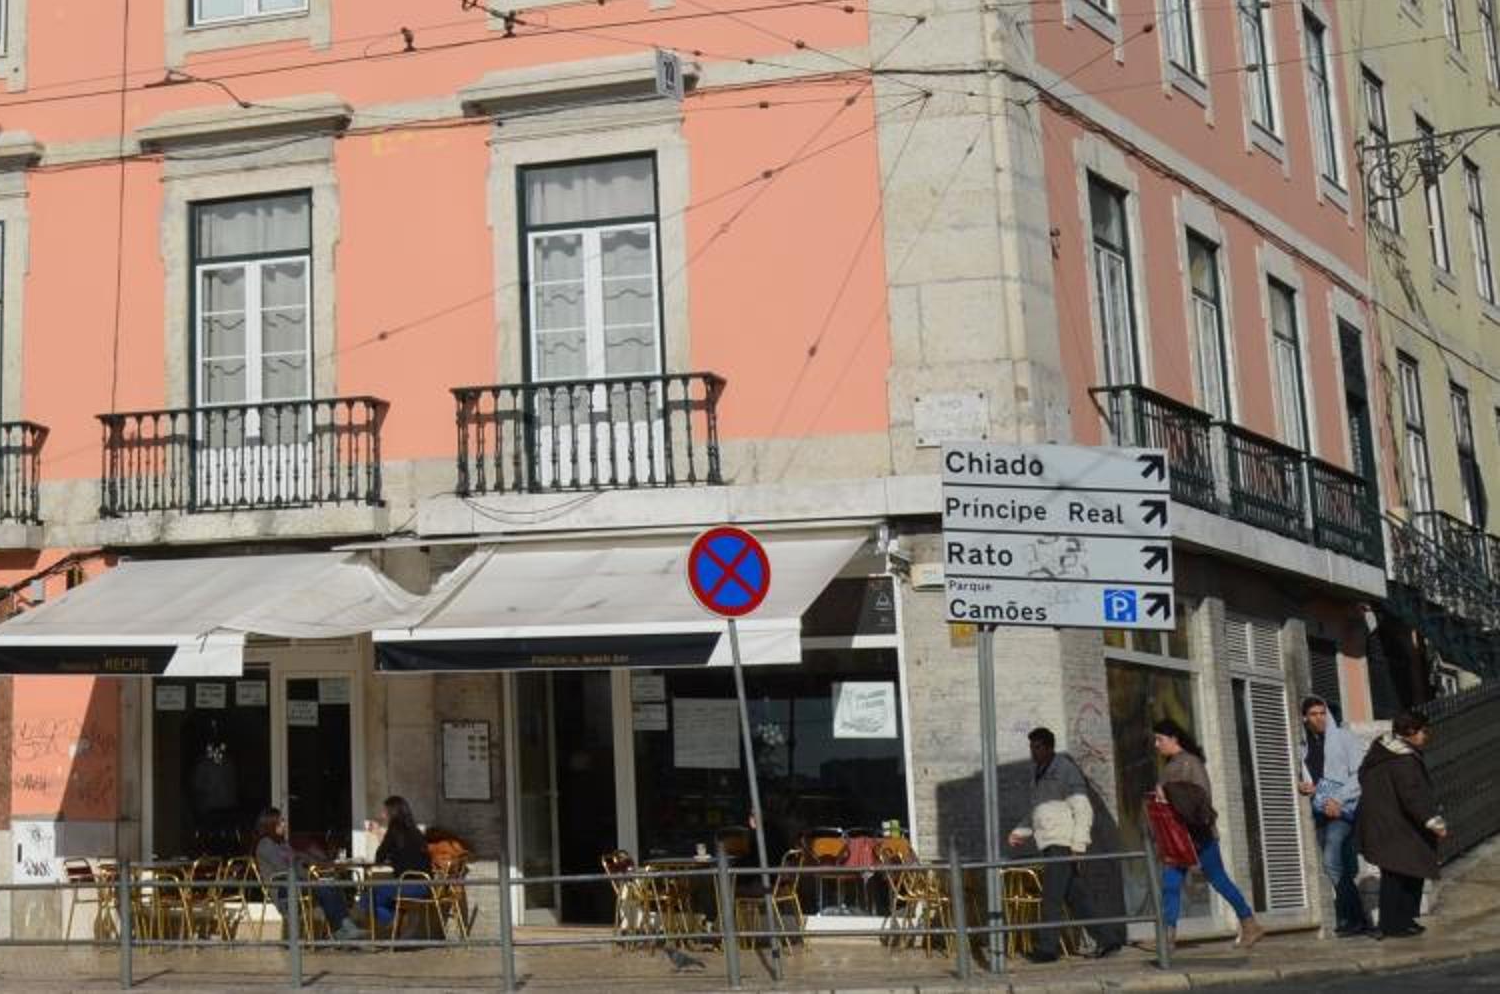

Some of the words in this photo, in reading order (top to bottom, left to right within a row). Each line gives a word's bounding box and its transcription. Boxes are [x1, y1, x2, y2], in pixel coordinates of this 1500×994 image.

[945, 451, 1044, 476] Chiado
[945, 497, 1047, 523] Príncipe
[1068, 502, 1124, 524] Real
[947, 542, 1013, 566] Rato
[950, 580, 992, 592] Parque
[950, 599, 1047, 621] Camões
